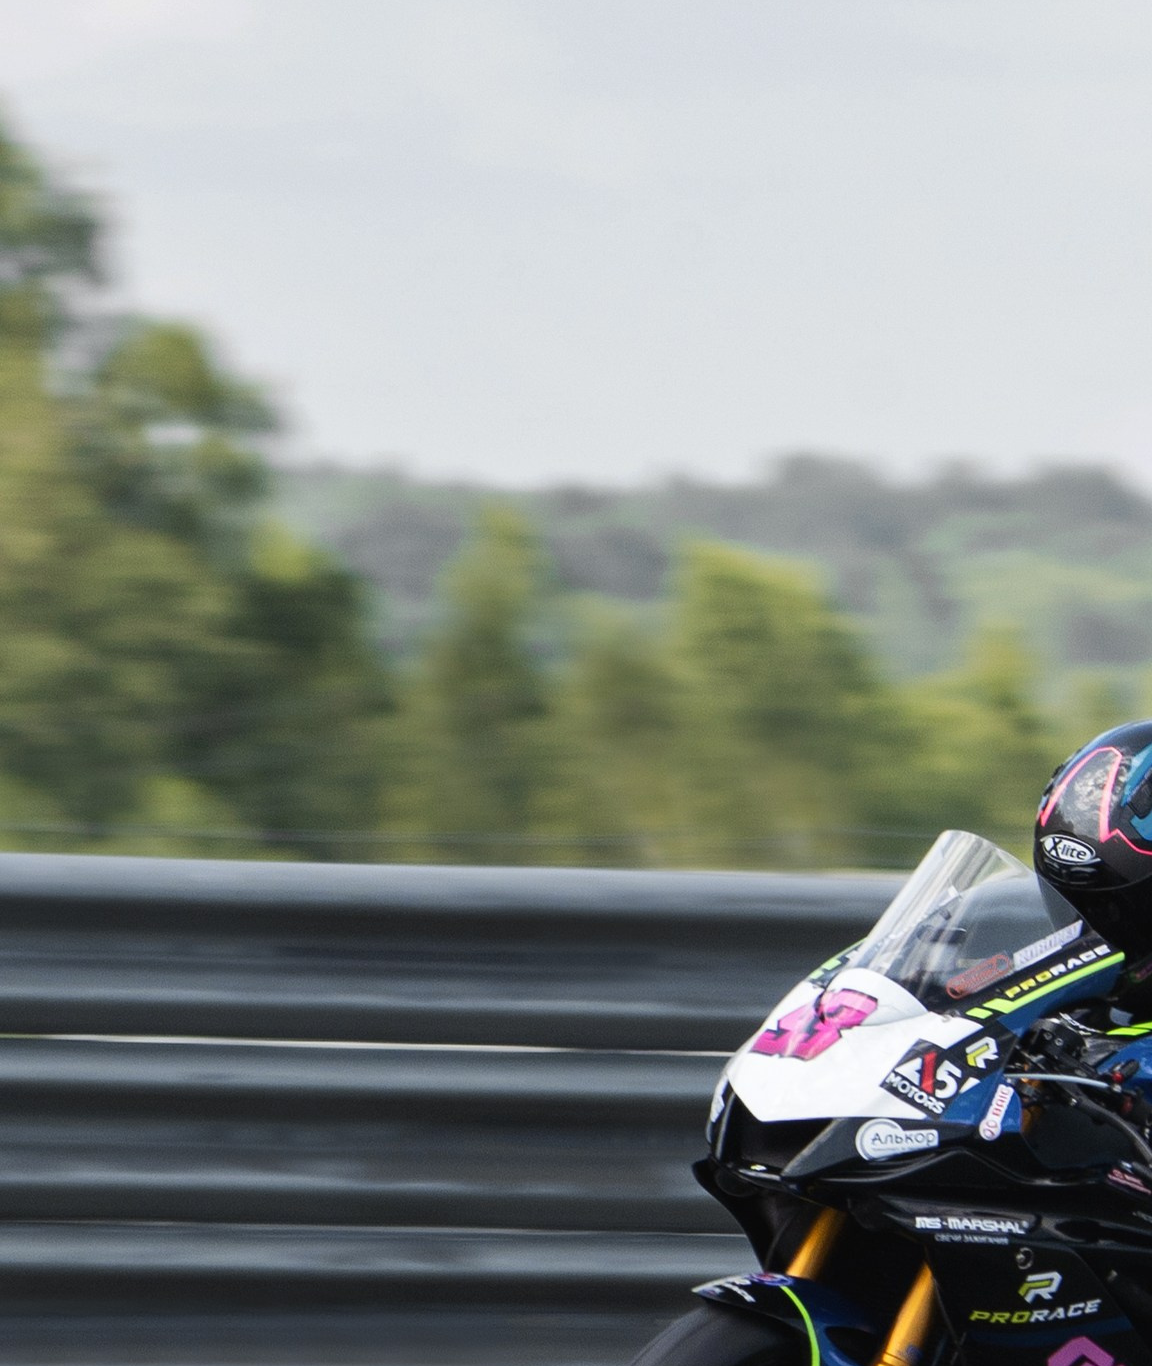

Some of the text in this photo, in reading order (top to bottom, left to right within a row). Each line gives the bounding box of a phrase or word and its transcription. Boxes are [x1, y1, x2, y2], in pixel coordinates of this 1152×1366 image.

[1047, 836, 1087, 861] X-lite
[1004, 944, 1111, 998] PRORACE
[884, 1072, 946, 1115] MOTORS
[870, 1132, 937, 1147] Алькор
[969, 1298, 1102, 1324] PRORACE
